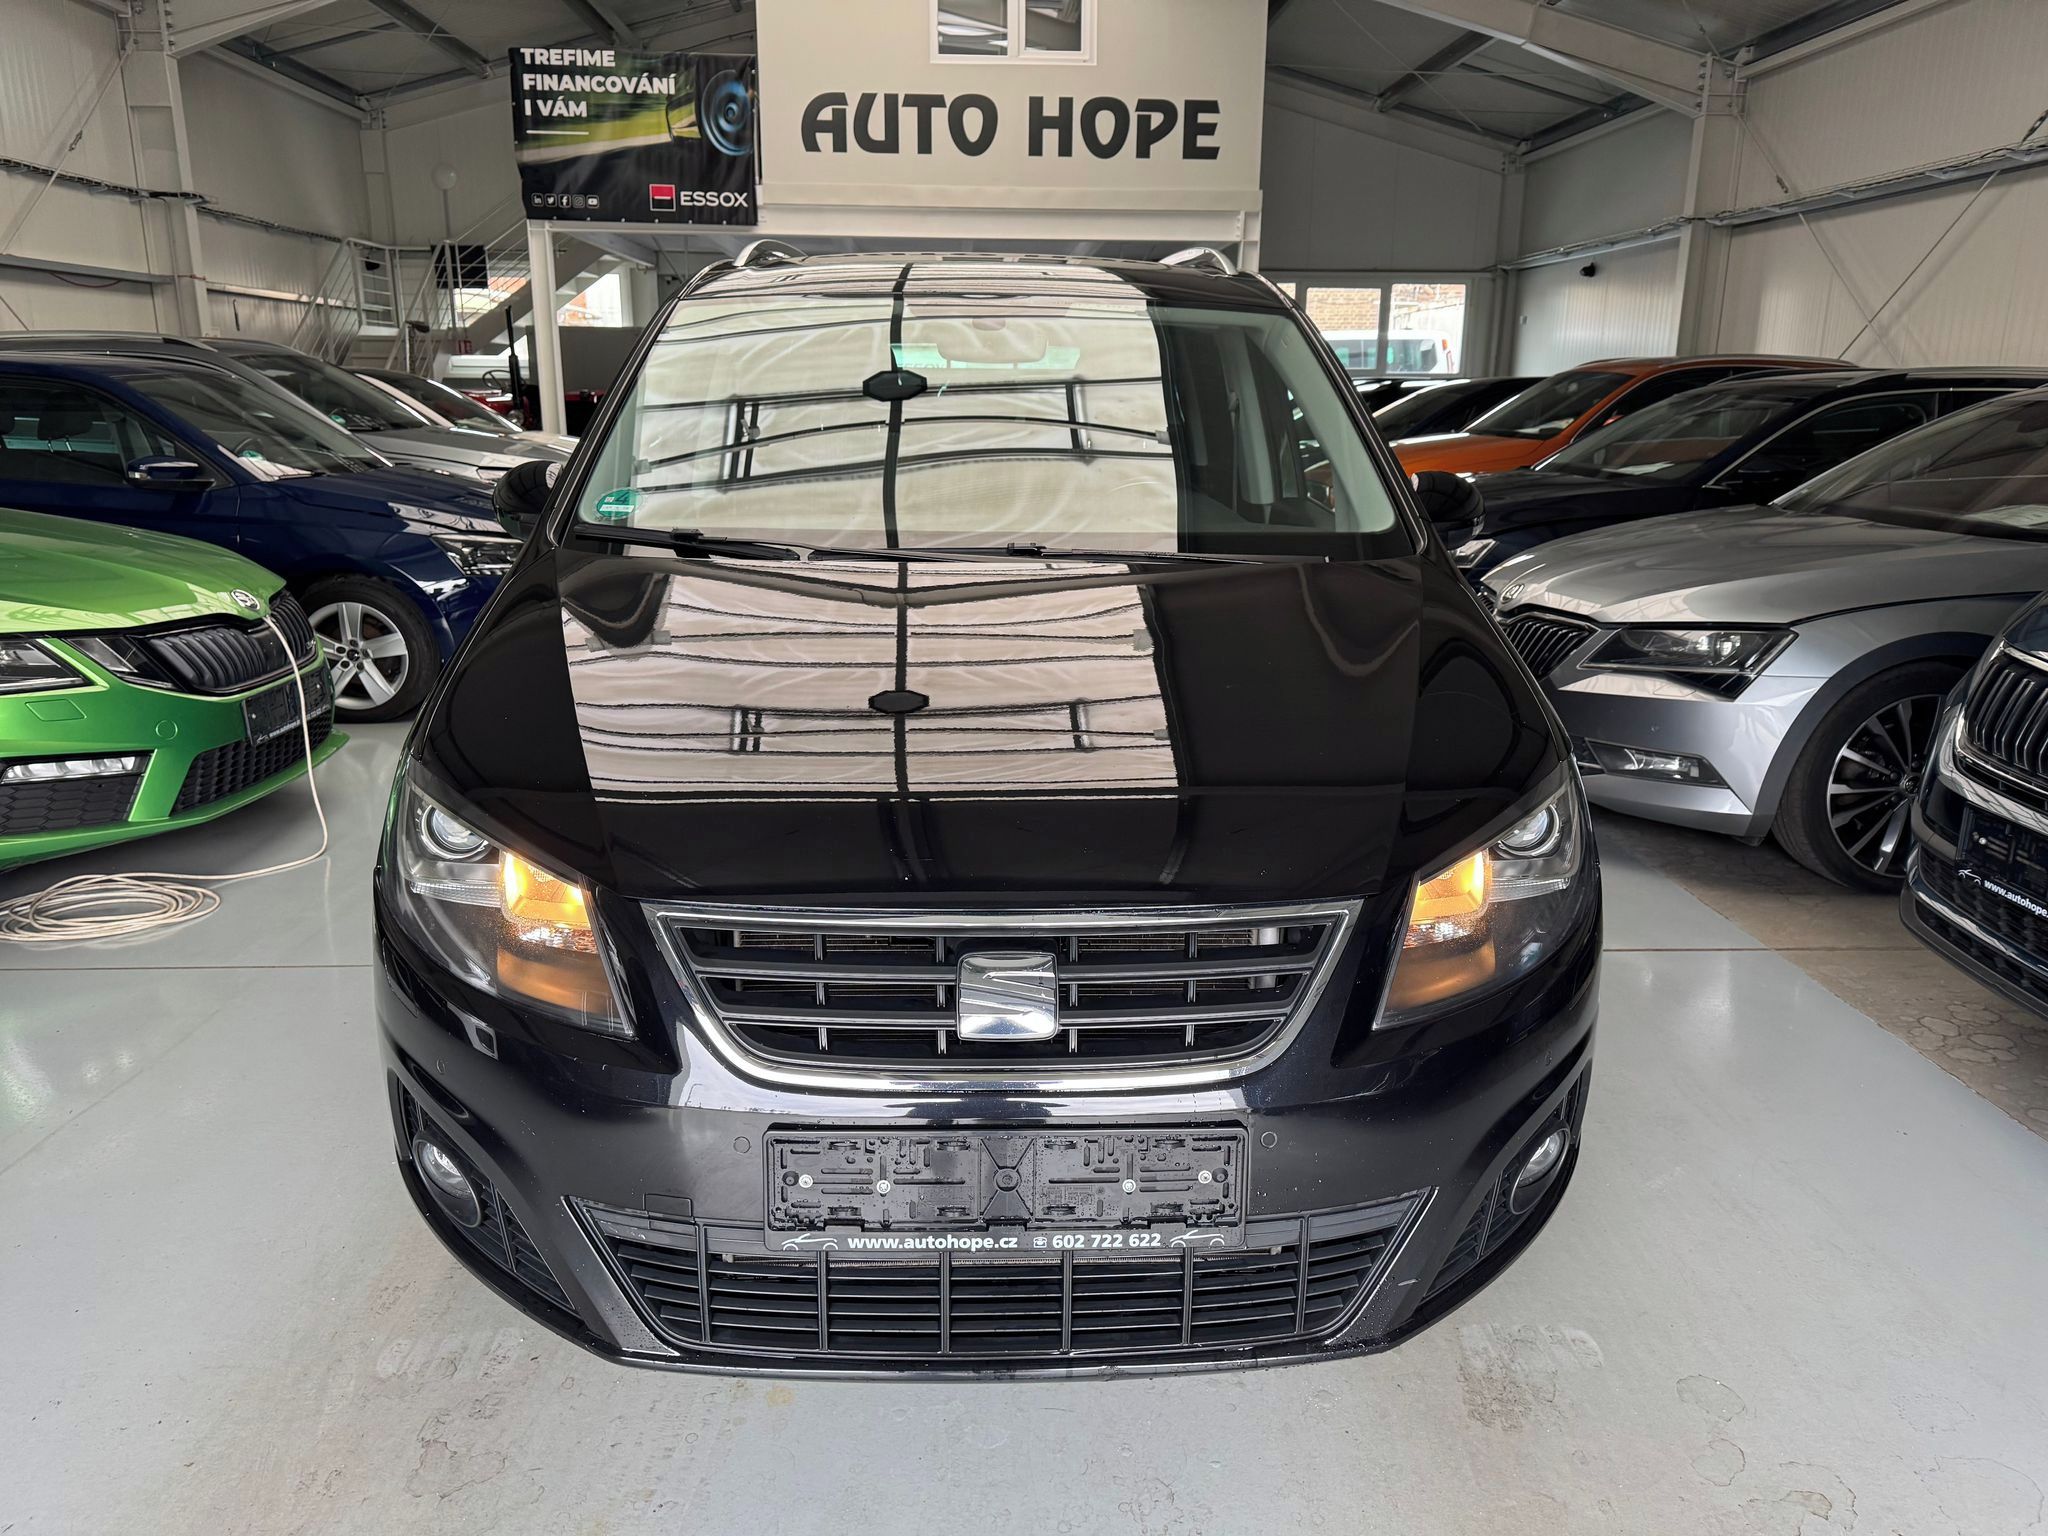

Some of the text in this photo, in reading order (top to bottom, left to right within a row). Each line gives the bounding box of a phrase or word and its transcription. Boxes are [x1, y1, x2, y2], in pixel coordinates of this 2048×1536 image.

[520, 48, 616, 67] TREFIME
[522, 73, 677, 95] FINANCOVÁNÍ
[524, 96, 588, 118] I VÁM
[801, 92, 1220, 160] AUTO HOPE
[680, 191, 749, 208] ESSOX
[847, 1233, 1161, 1252] www.autohope.cz 602 722 622
